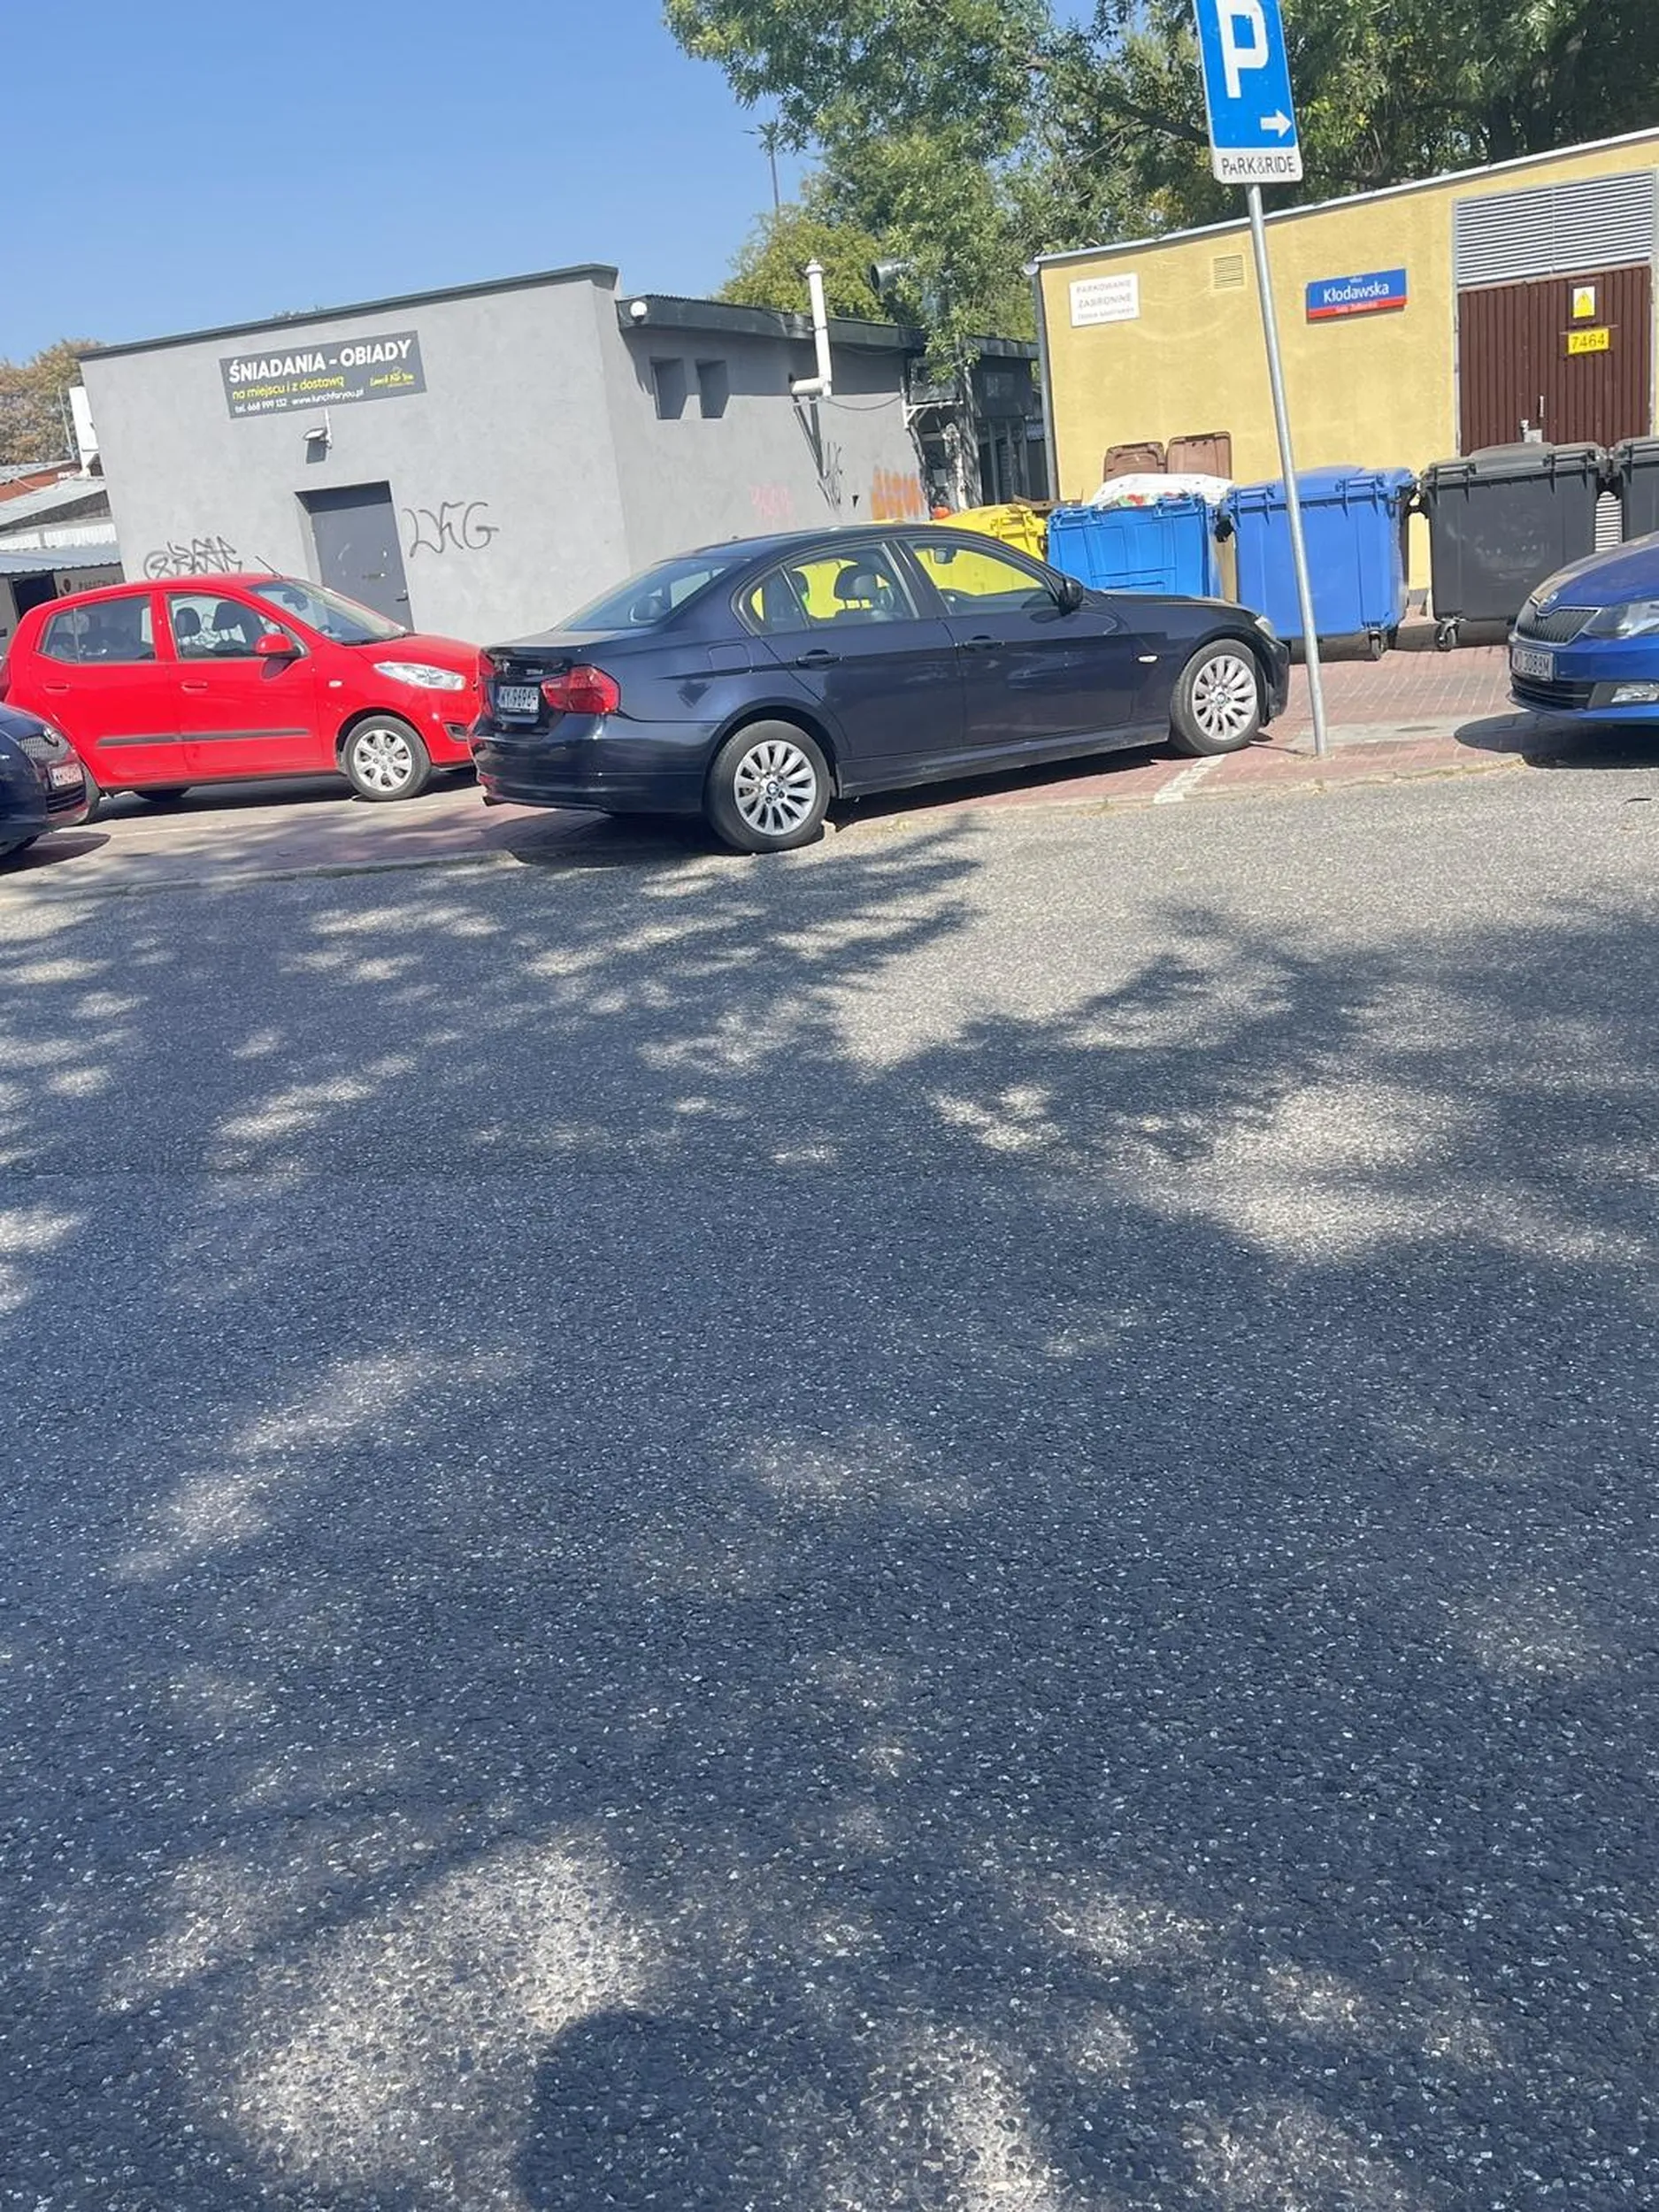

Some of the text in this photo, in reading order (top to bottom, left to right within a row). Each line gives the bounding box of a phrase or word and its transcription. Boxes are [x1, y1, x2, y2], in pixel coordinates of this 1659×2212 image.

[1216, 0, 1269, 98] P
[1323, 281, 1390, 303] Kłodawska
[1572, 333, 1605, 350] 7464
[228, 352, 326, 383] ŚNIADANIA
[340, 339, 411, 366] OBIADY
[233, 390, 244, 400] na
[247, 383, 285, 399] miejscu
[292, 382, 298, 392] z
[299, 375, 344, 391] dostawą
